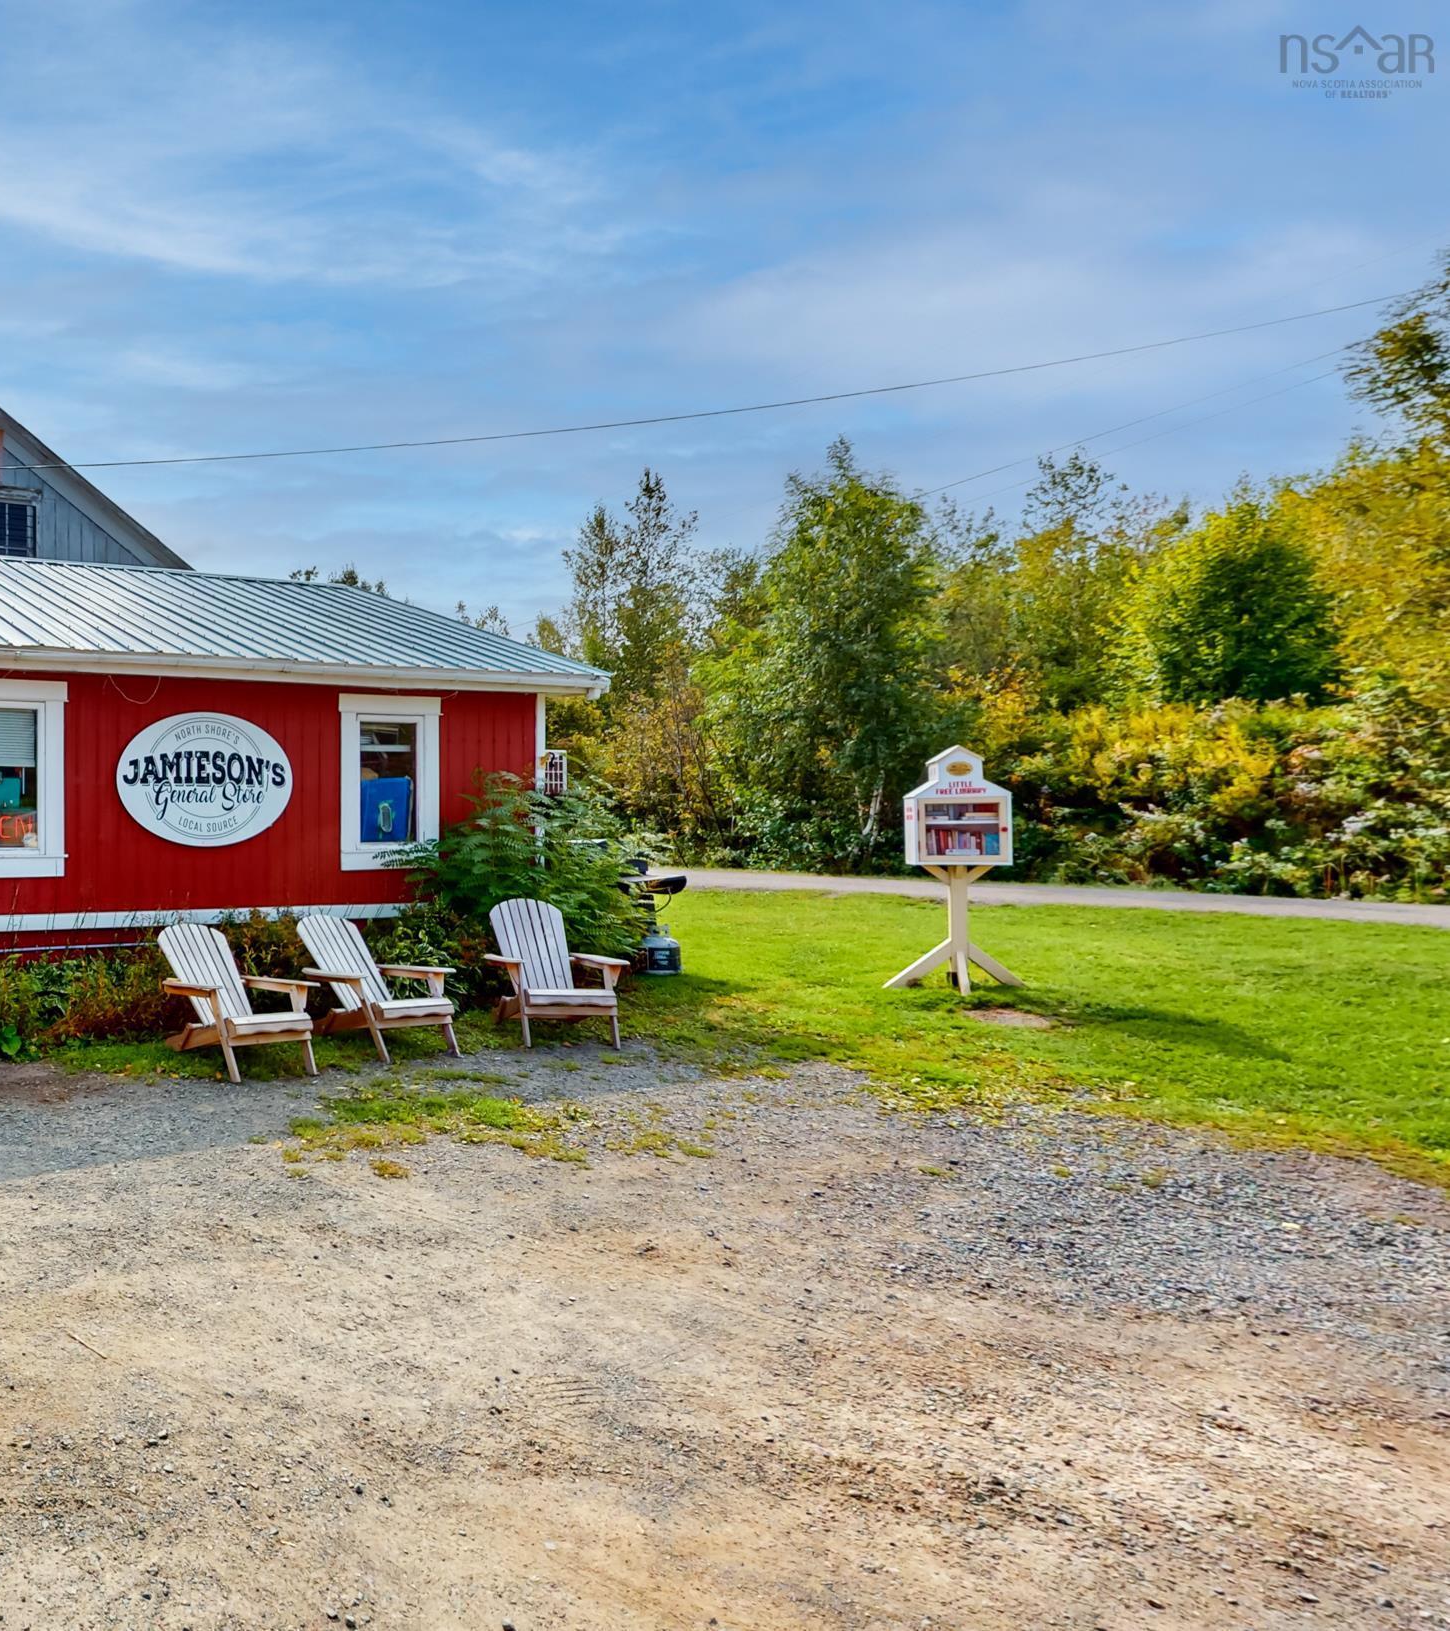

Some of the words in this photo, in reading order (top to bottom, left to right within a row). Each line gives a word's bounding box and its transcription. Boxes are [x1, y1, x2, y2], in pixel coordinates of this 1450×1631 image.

[174, 724, 202, 742] NORTH
[204, 724, 241, 745] SHORE'S
[122, 750, 286, 788] JAMIESON'S
[153, 780, 216, 821] General
[221, 781, 265, 812] Store
[955, 787, 987, 795] LIBRARY
[178, 815, 204, 833] LOCAL
[206, 815, 239, 833] SOURCE
